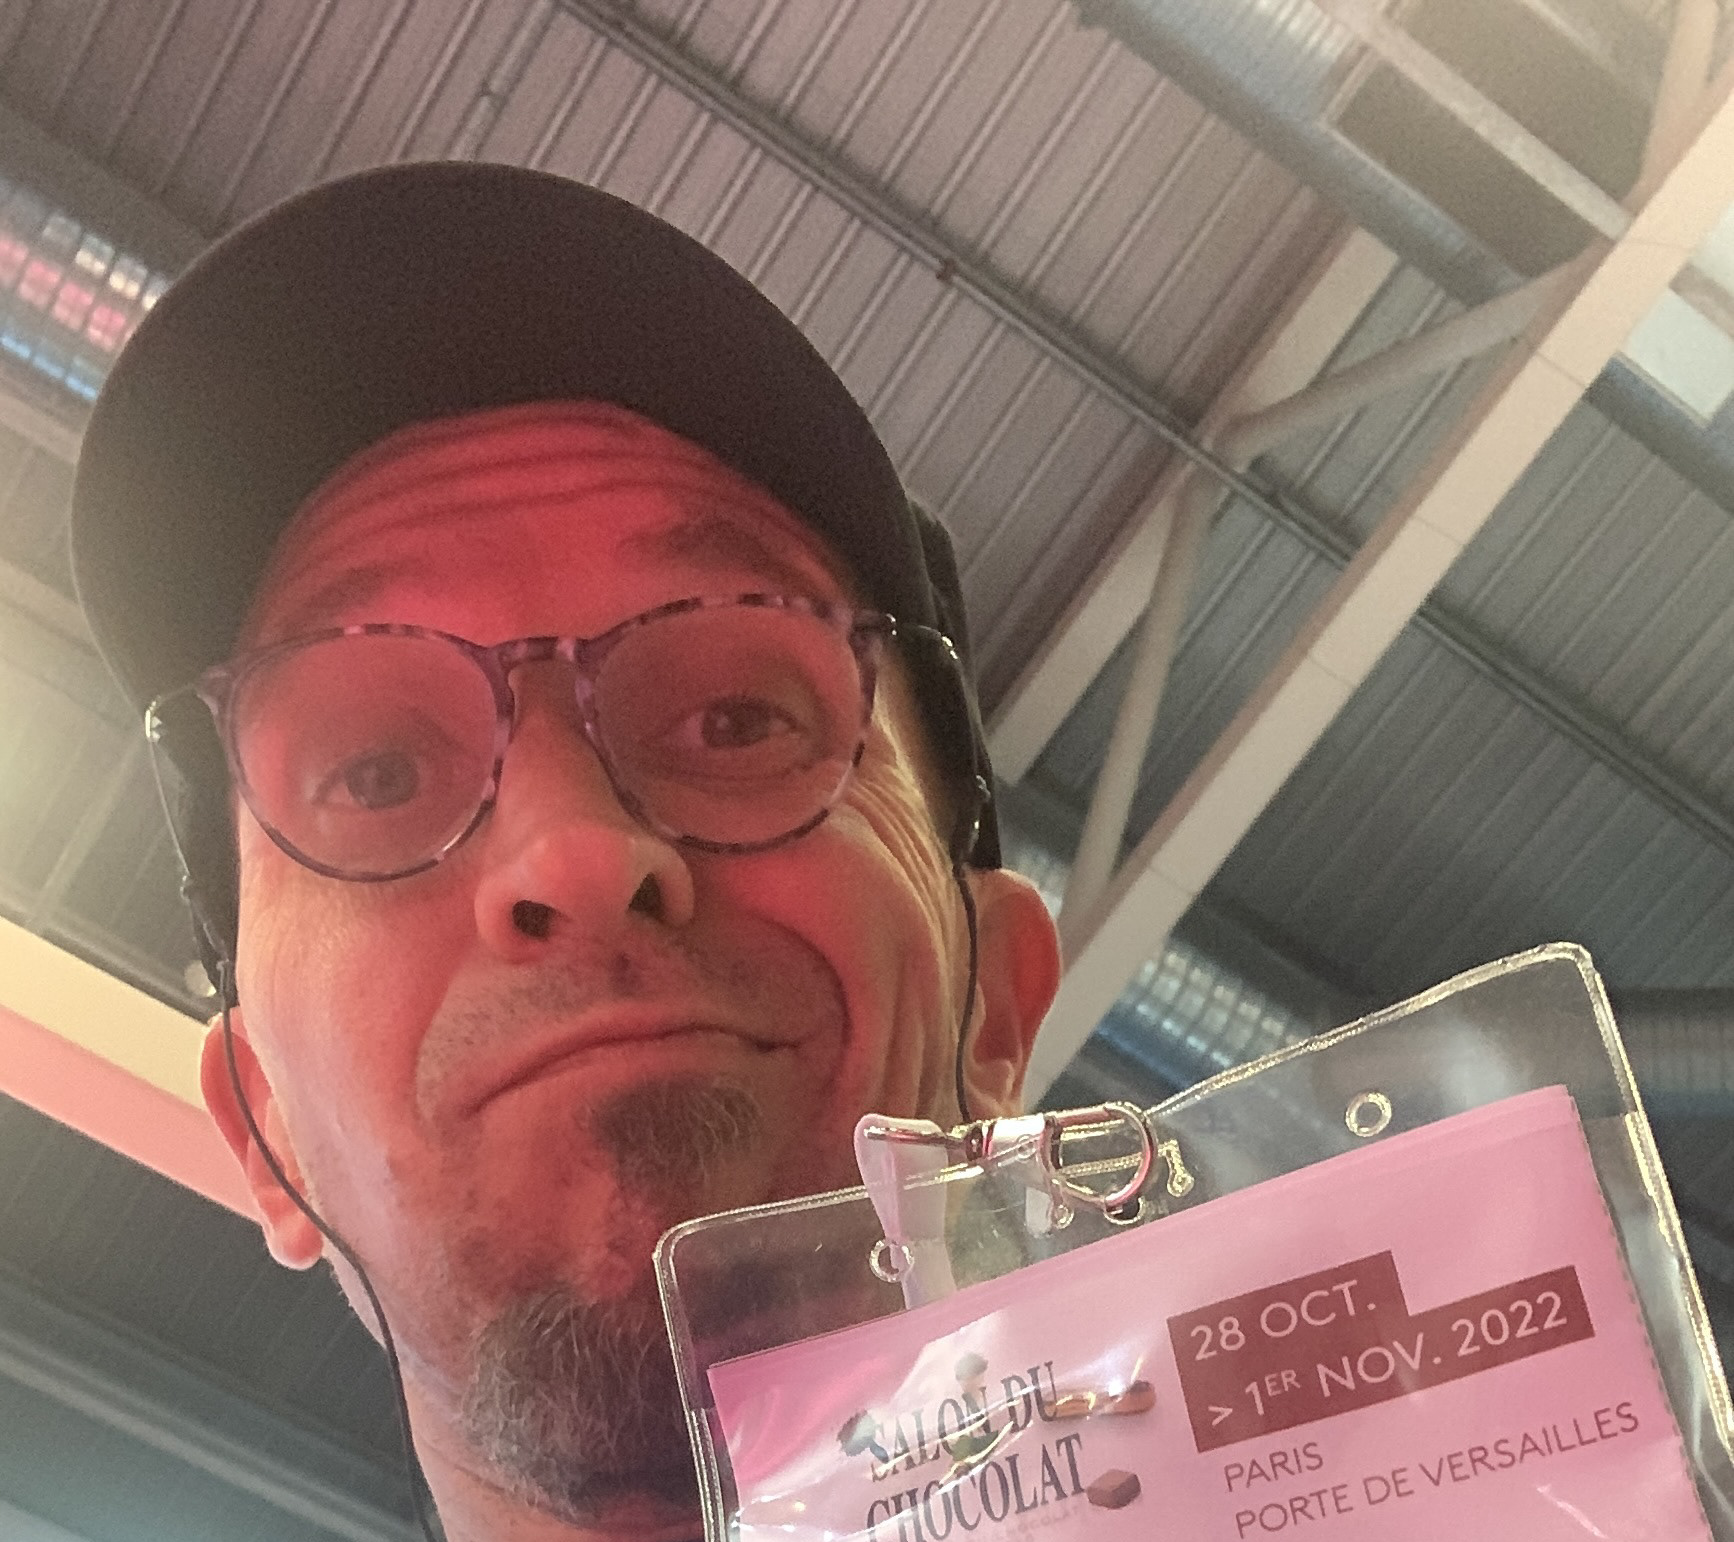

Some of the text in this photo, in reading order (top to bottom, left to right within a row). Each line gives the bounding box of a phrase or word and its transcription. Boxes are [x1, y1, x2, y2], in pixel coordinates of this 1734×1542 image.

[1190, 1280, 1377, 1362] 28 OCT.
[1316, 1331, 1443, 1398] NOV.
[1451, 1290, 1568, 1358] 2022
[871, 1361, 1059, 1482] SALON DU
[1223, 1441, 1325, 1493] PARIS
[1235, 1402, 1640, 1539] PORTE DE VERSAILLES
